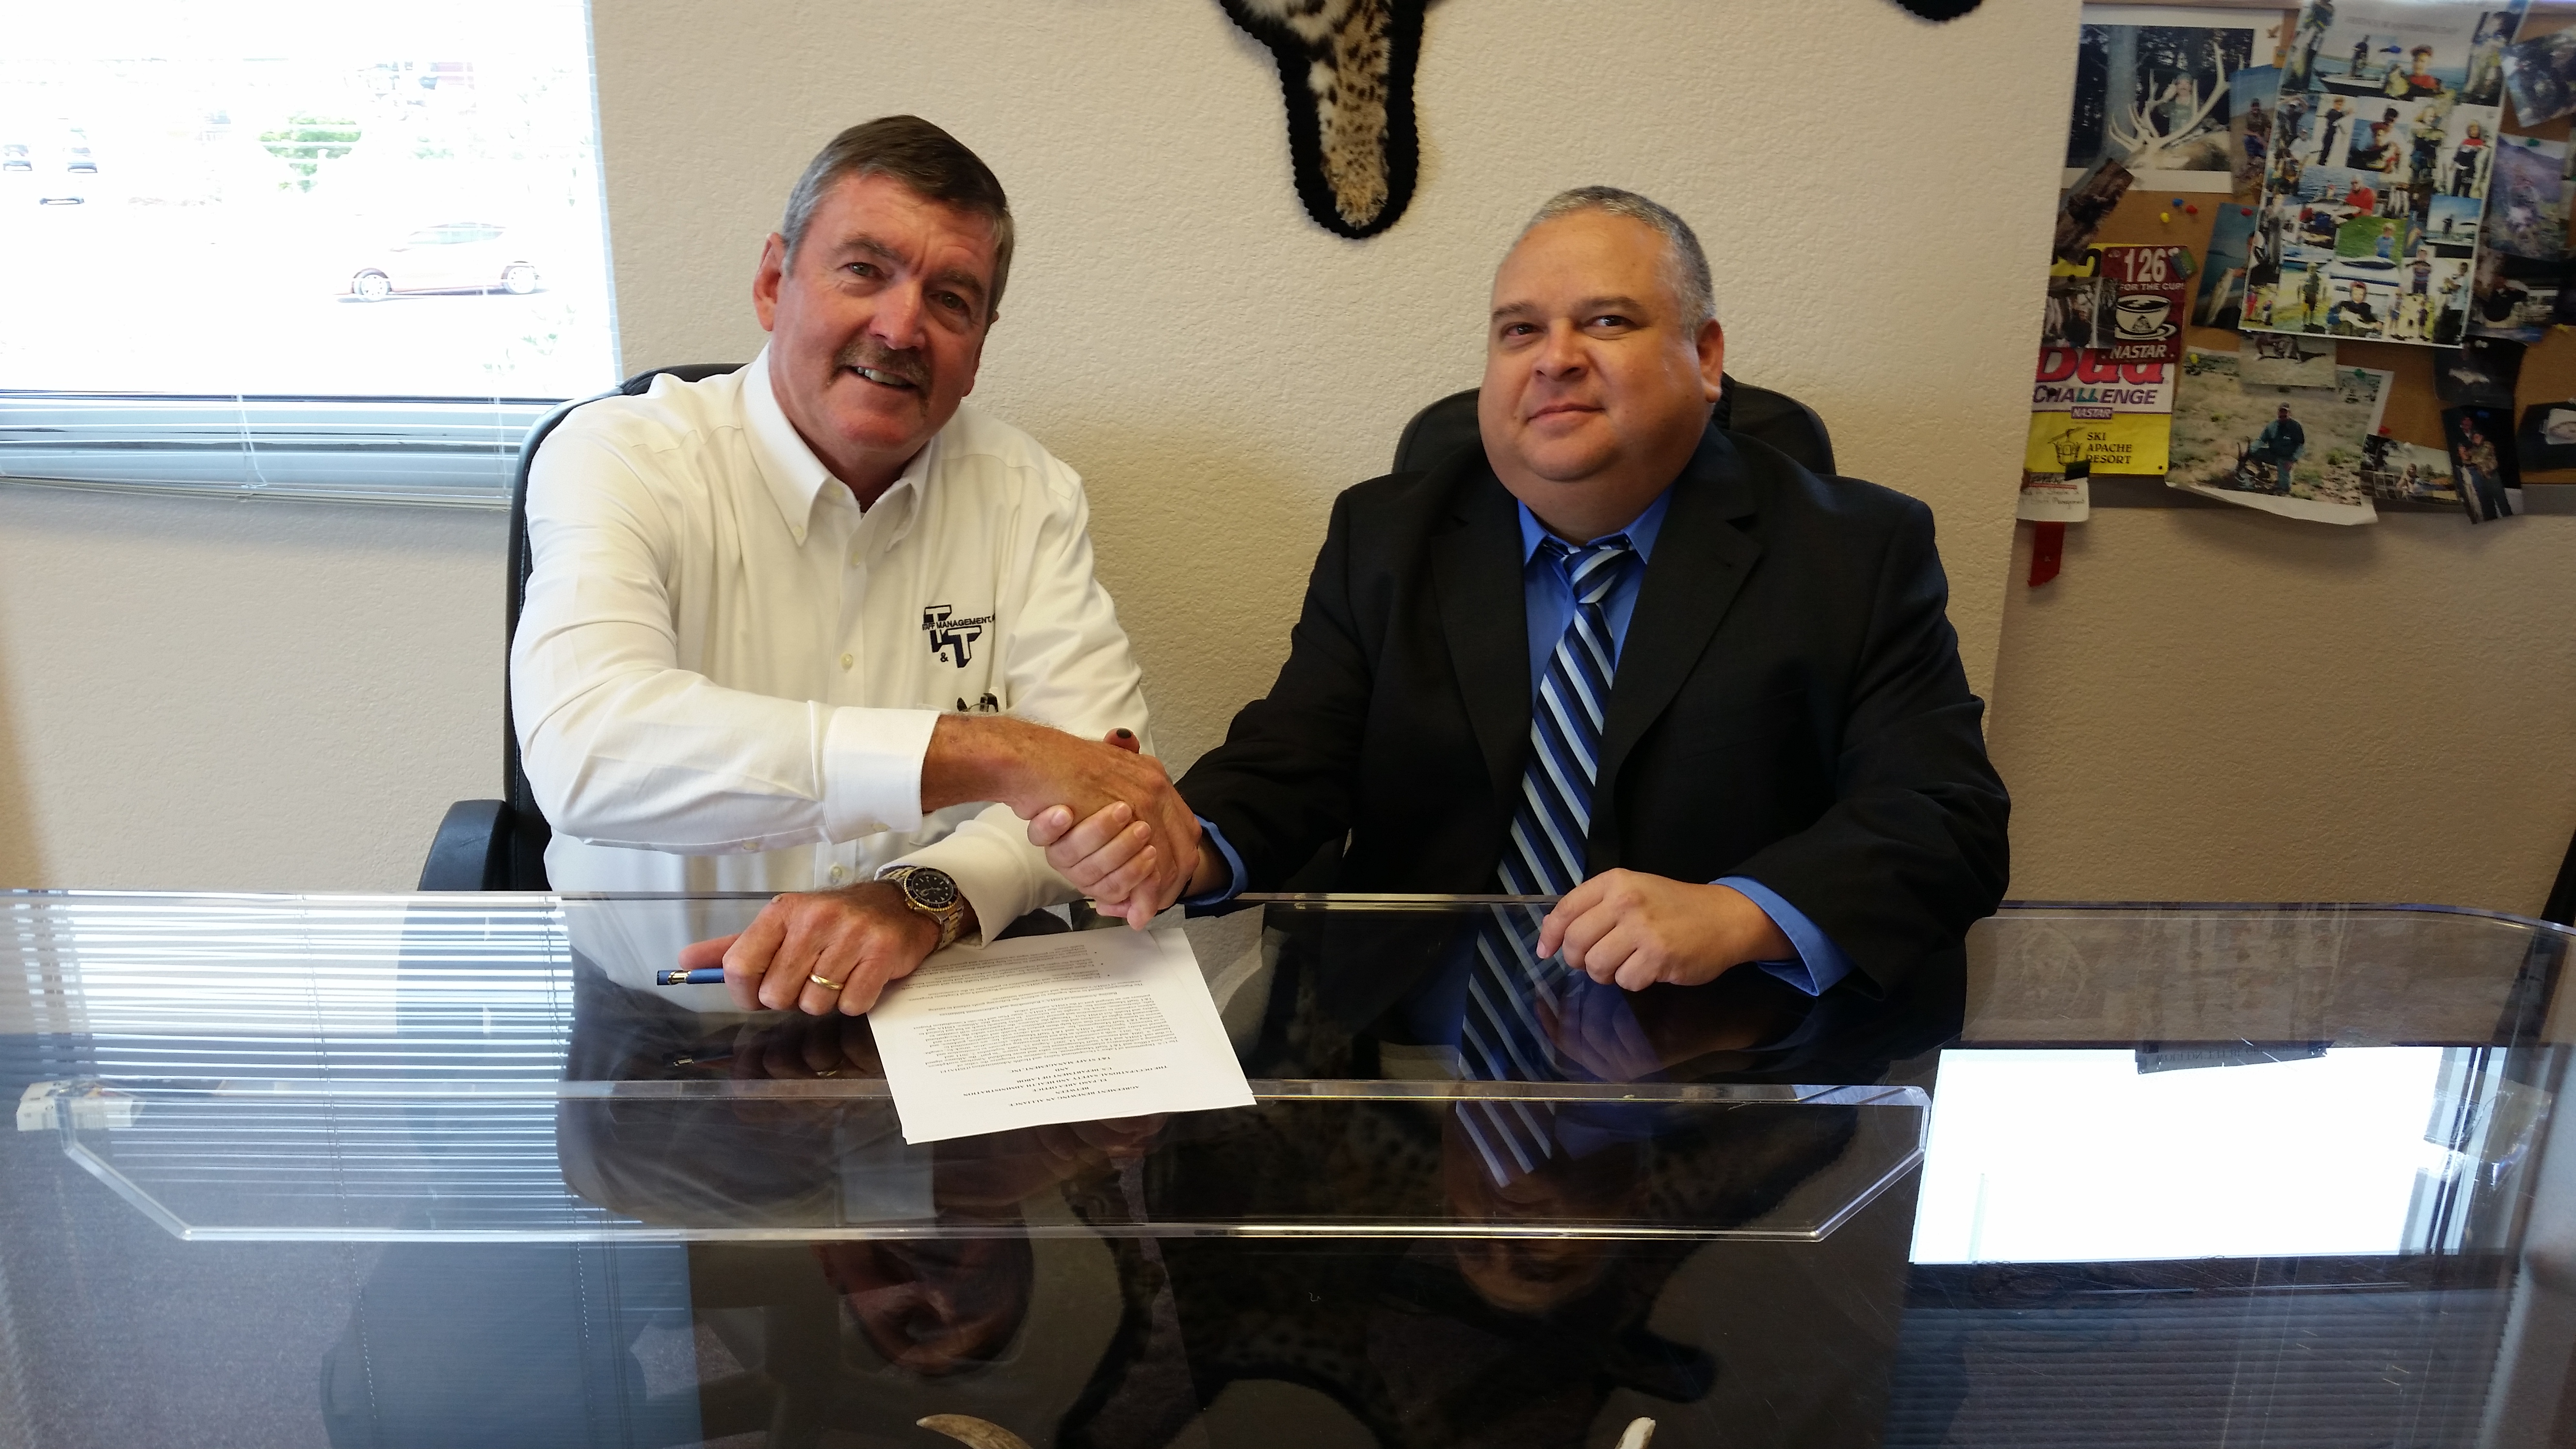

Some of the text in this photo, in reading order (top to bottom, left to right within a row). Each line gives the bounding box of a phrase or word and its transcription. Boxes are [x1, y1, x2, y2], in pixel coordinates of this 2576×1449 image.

[2124, 248, 2167, 282] 126
[2110, 344, 2167, 358] NASTAR
[2033, 386, 2157, 404] CHALLENGE
[2073, 409, 2110, 418] NASTAR
[2087, 432, 2106, 441] SKI
[2087, 444, 2132, 452] APACHE
[2086, 454, 2131, 464] RESORT
[922, 622, 935, 630] STAFF
[940, 652, 949, 662] &
[1052, 1068, 1099, 1078] DEPARTMENT
[1099, 1067, 1153, 1076] OCCUPATIONAL
[963, 1085, 1024, 1096] ADMINISTRATION
[1097, 1085, 1140, 1094] AGREEMENT
[1057, 1091, 1095, 1099] RENEWING
